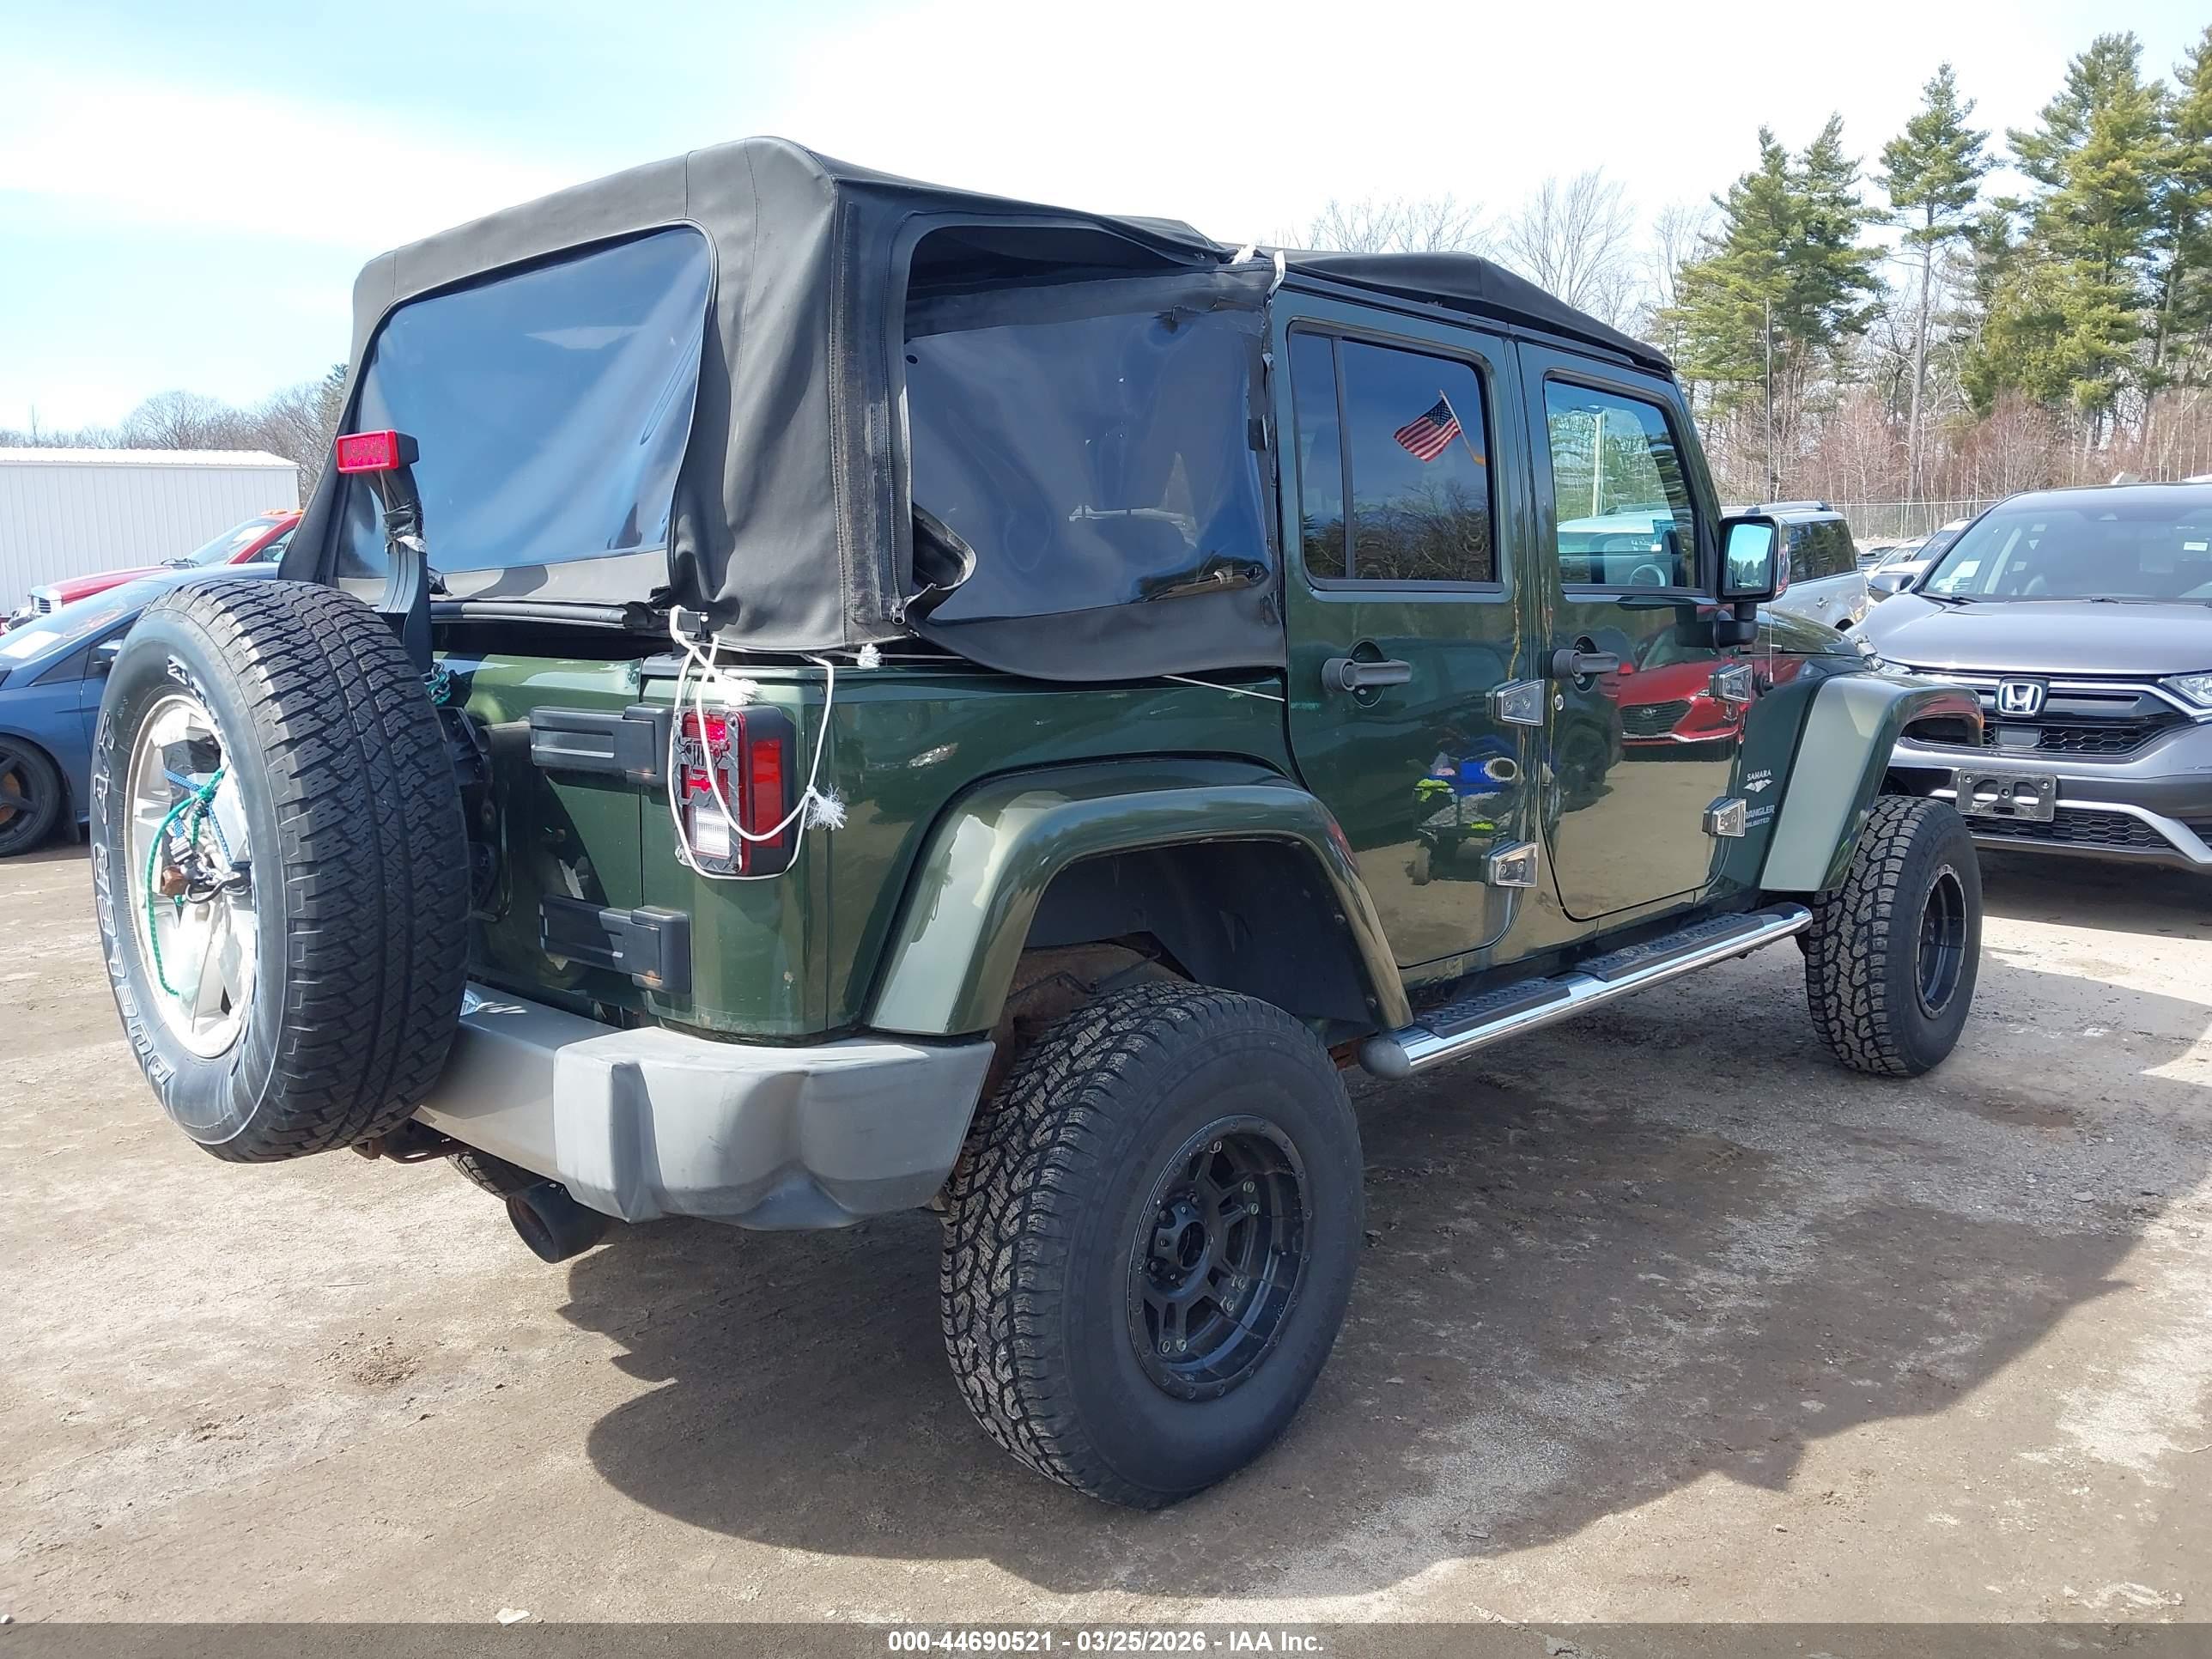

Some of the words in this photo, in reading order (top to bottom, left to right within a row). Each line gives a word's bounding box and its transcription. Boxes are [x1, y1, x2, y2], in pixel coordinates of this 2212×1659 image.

[1747, 769, 1772, 781] SAHARA
[1745, 805, 1775, 819] RANGLER
[93, 842, 175, 1085] DUELER
